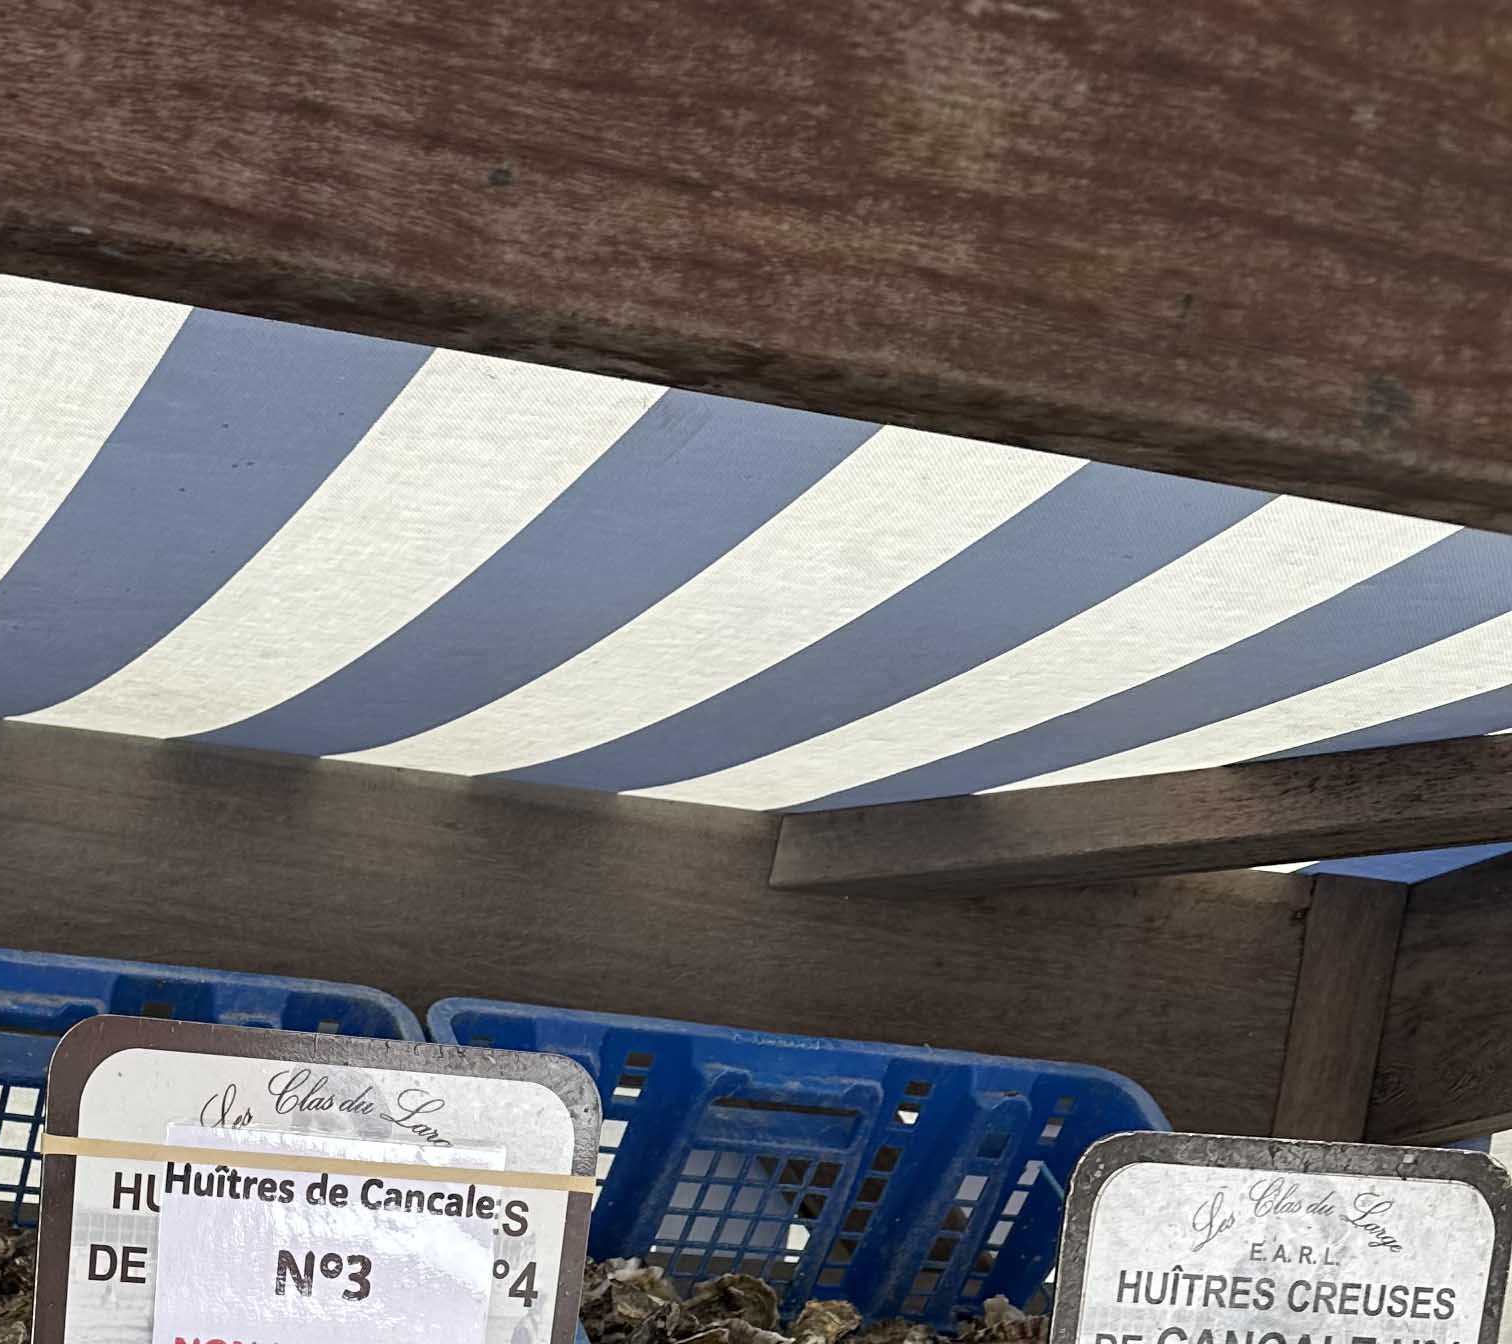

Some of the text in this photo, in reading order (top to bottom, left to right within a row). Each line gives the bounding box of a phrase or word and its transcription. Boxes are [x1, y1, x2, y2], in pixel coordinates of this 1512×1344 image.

[267, 1068, 334, 1116] Clas
[335, 1086, 375, 1116] du
[381, 1088, 451, 1146] Lar
[165, 1161, 294, 1203] Huîtres
[306, 1173, 348, 1207] de
[361, 1179, 494, 1219] Cancale
[1192, 1177, 1403, 1254] Les Clas du Large
[88, 1244, 147, 1283] DE
[275, 1250, 371, 1301] N°3
[1117, 1265, 1455, 1320] HUÎTRES CREUSES
